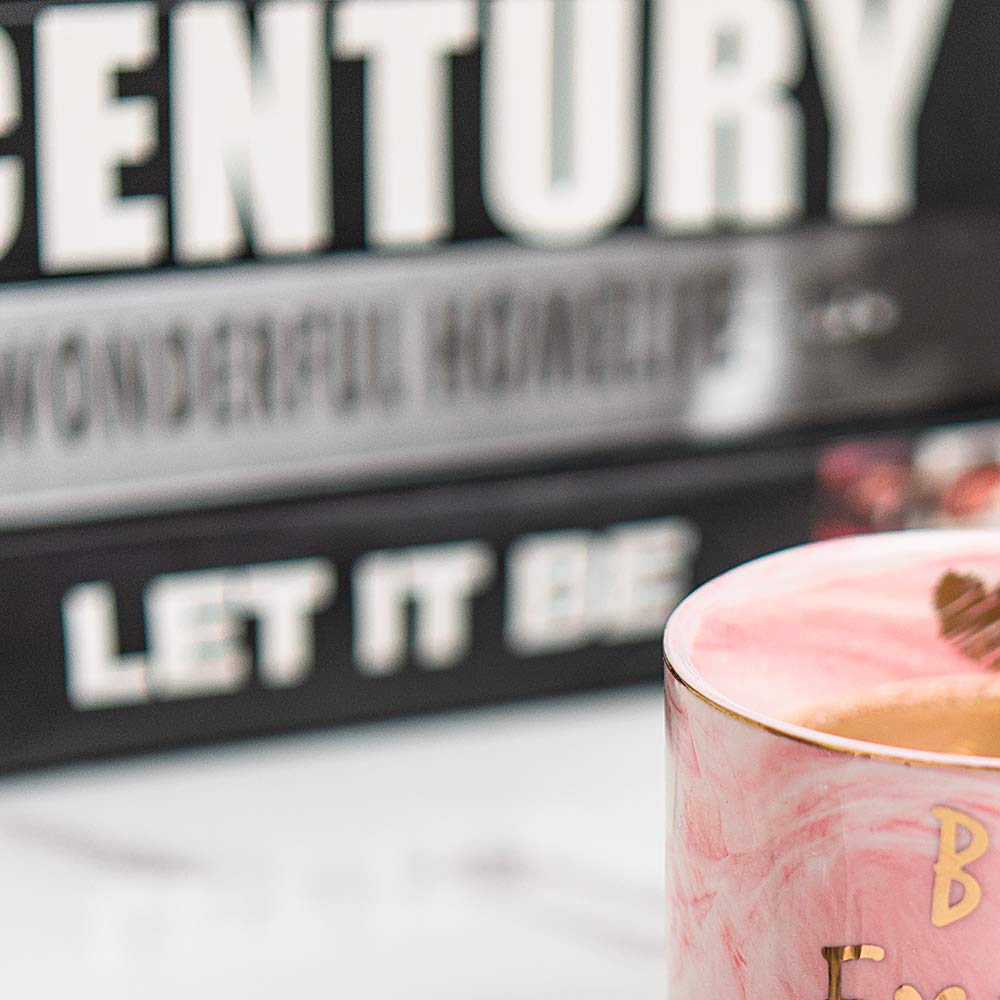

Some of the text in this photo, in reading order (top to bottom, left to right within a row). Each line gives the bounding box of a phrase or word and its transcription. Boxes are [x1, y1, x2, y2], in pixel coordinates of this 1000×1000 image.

[0, 0, 948, 274] ENTURY
[61, 516, 697, 711] LET IT BE
